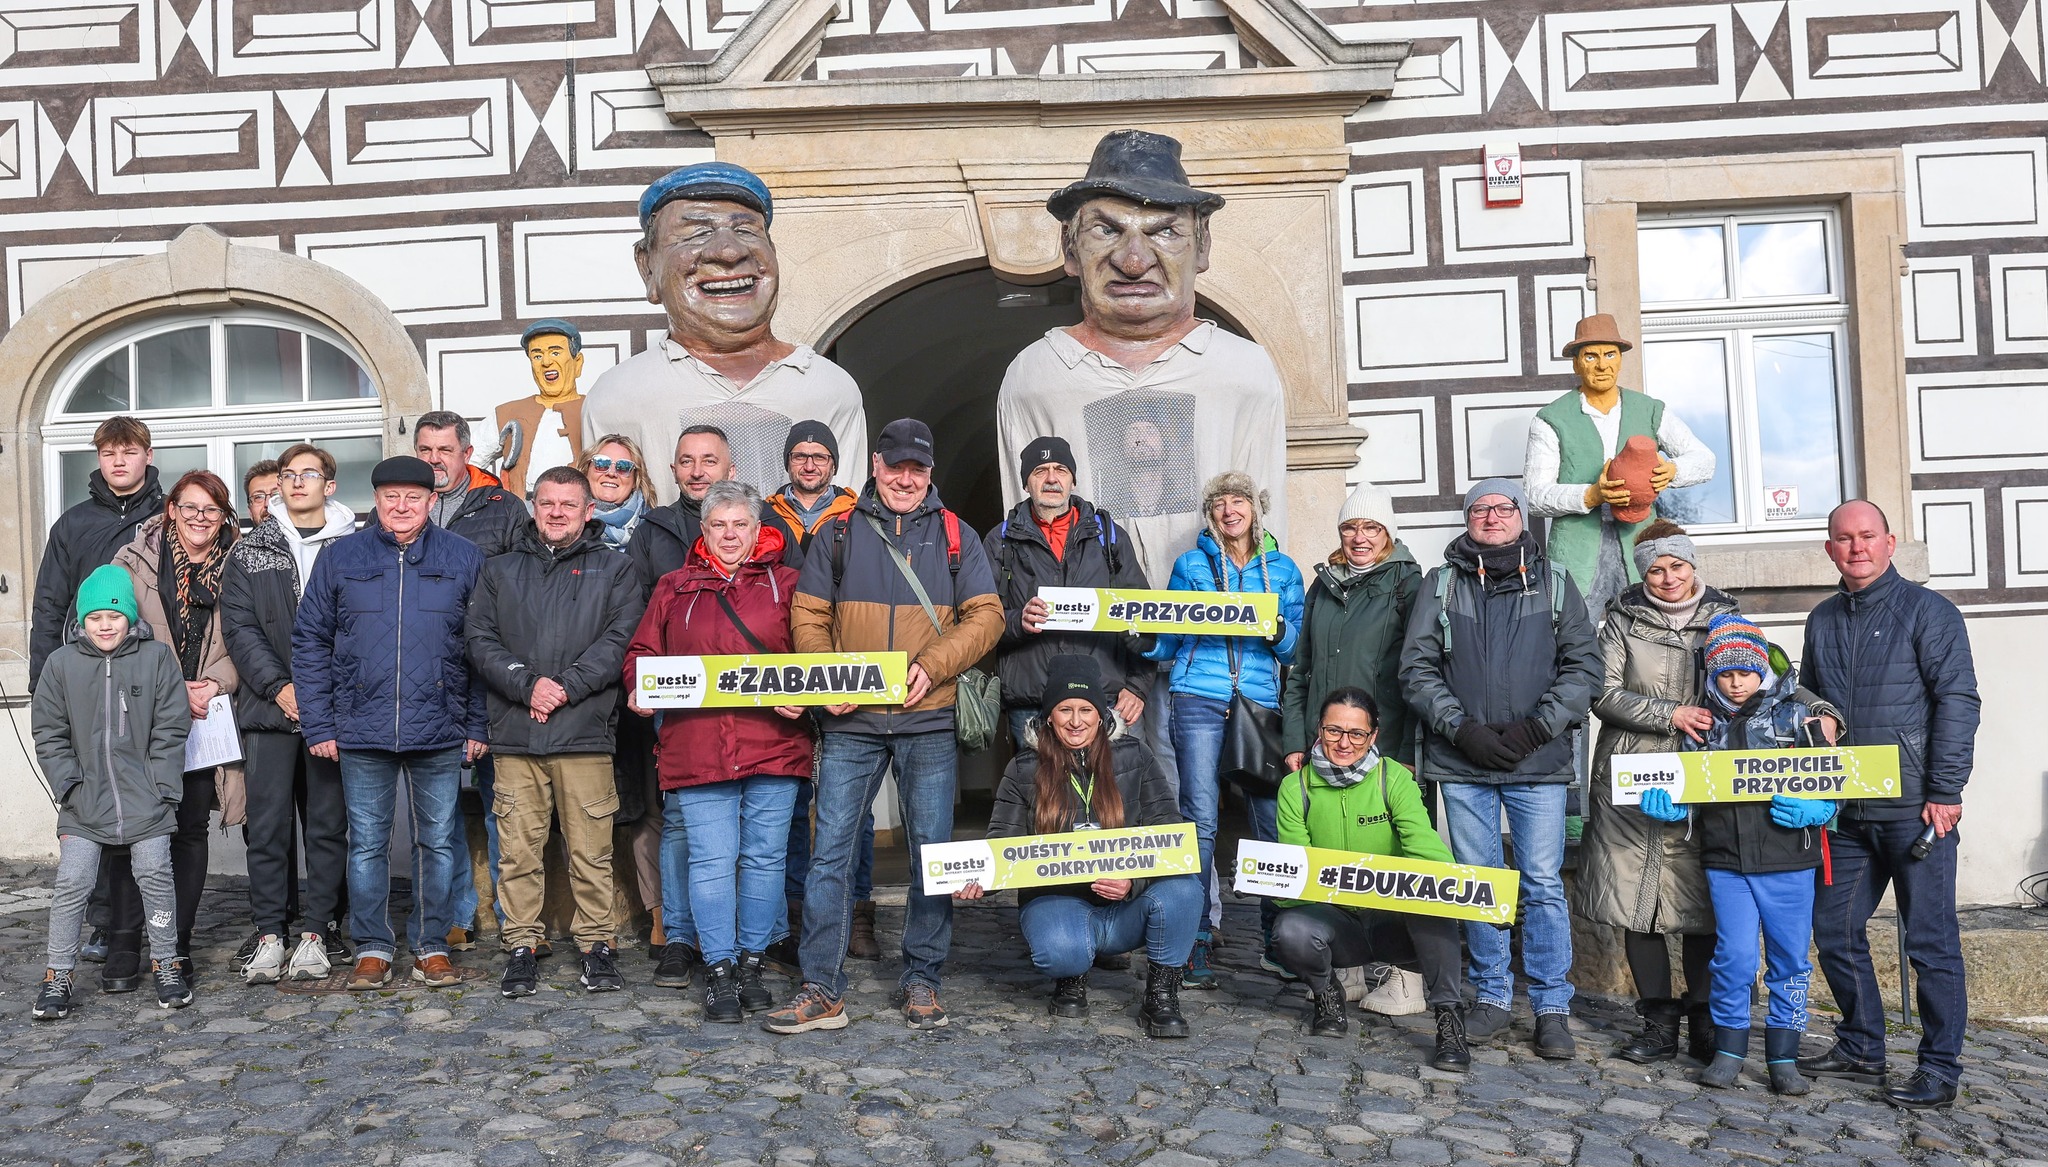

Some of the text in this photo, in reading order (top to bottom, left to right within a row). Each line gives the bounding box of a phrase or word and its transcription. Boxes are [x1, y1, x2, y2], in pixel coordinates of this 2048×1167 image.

[1108, 602, 1258, 624] #PRZYGODA
[718, 664, 885, 694] #ZABAWA
[1734, 755, 1843, 775] TROPICIEL
[1732, 775, 1847, 794] PRZYGODY
[1003, 843, 1073, 861] QUESTY
[1088, 833, 1185, 854] WYPRAWY
[1036, 854, 1156, 878] ODKRYWCÓW
[1319, 865, 1495, 906] #EDUKACJA
